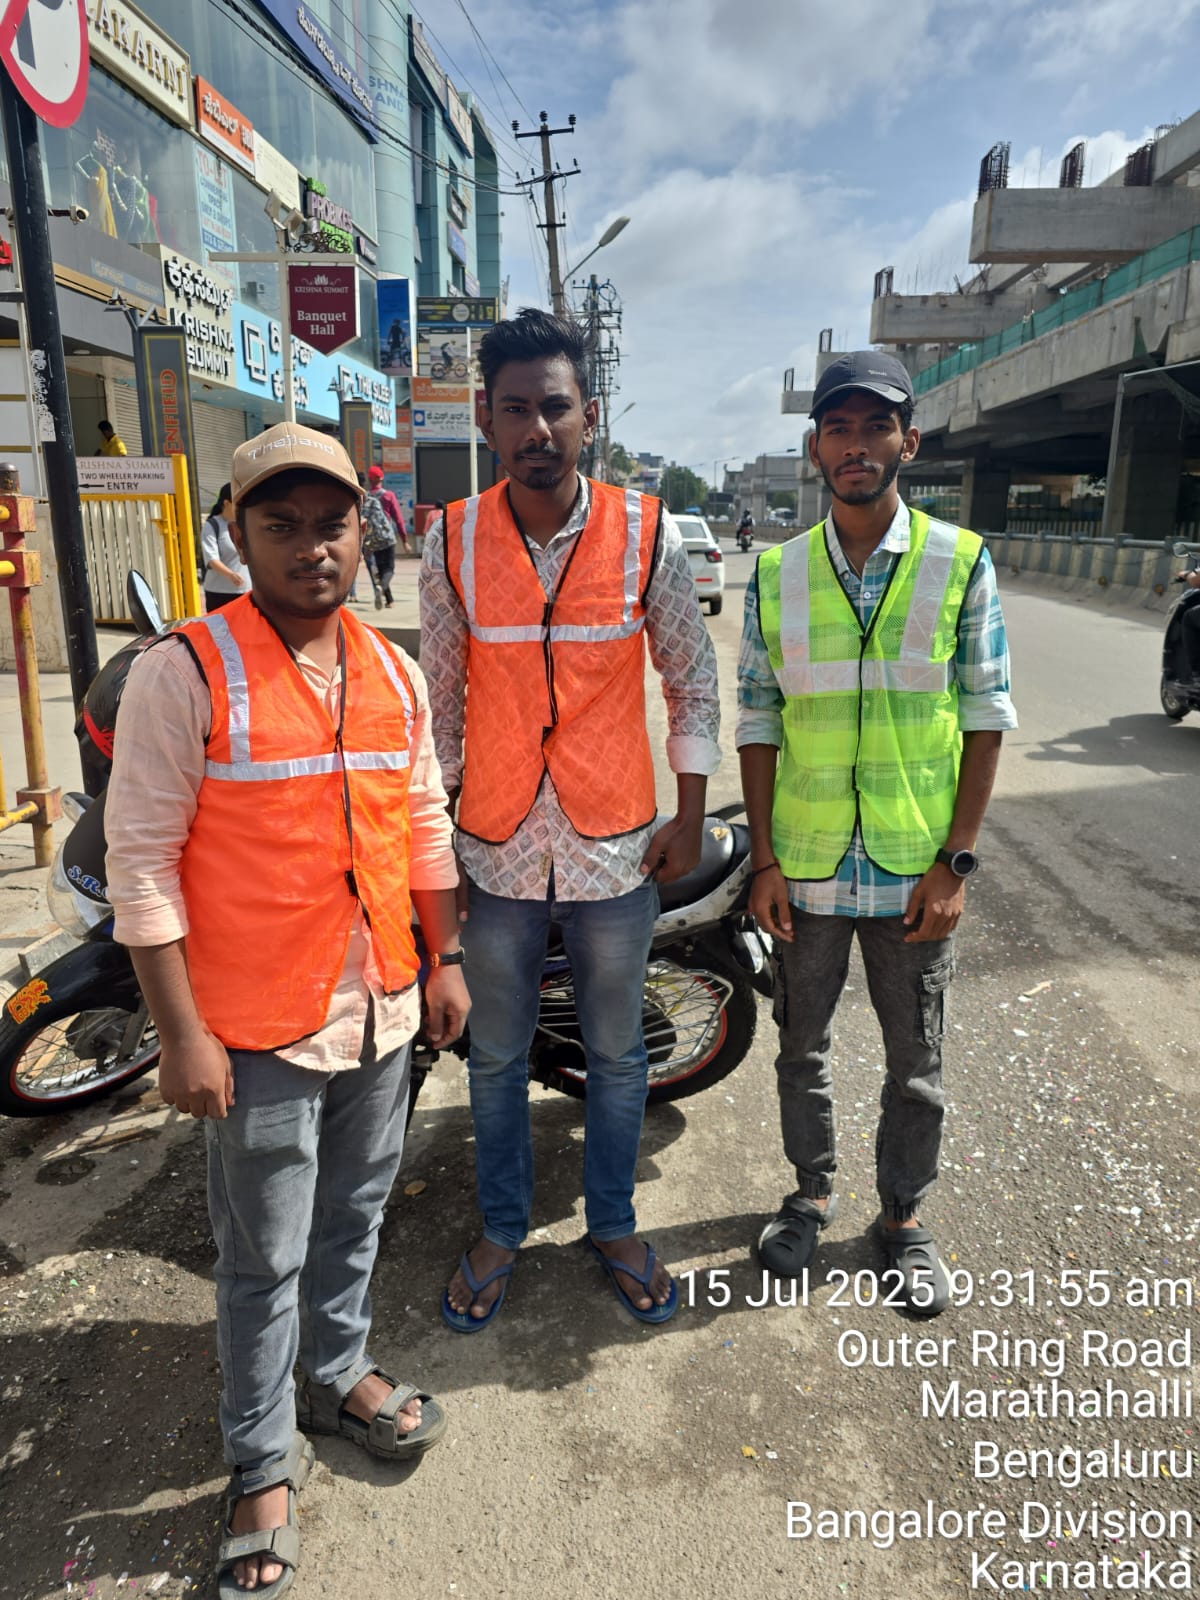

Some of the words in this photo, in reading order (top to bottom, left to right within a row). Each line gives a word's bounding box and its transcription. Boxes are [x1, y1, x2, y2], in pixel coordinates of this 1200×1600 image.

[86, 0, 187, 101] AKARNI
[294, 286, 322, 294] KRISHNA
[323, 286, 349, 294] SUMMIT
[297, 310, 347, 323] Banquet
[173, 308, 236, 353] KRISHNA
[310, 324, 335, 335] Hall
[187, 344, 231, 378] SUMMIT
[247, 433, 336, 460] Thailand
[126, 460, 170, 470] SUMMIT
[107, 482, 139, 490] ENTRY
